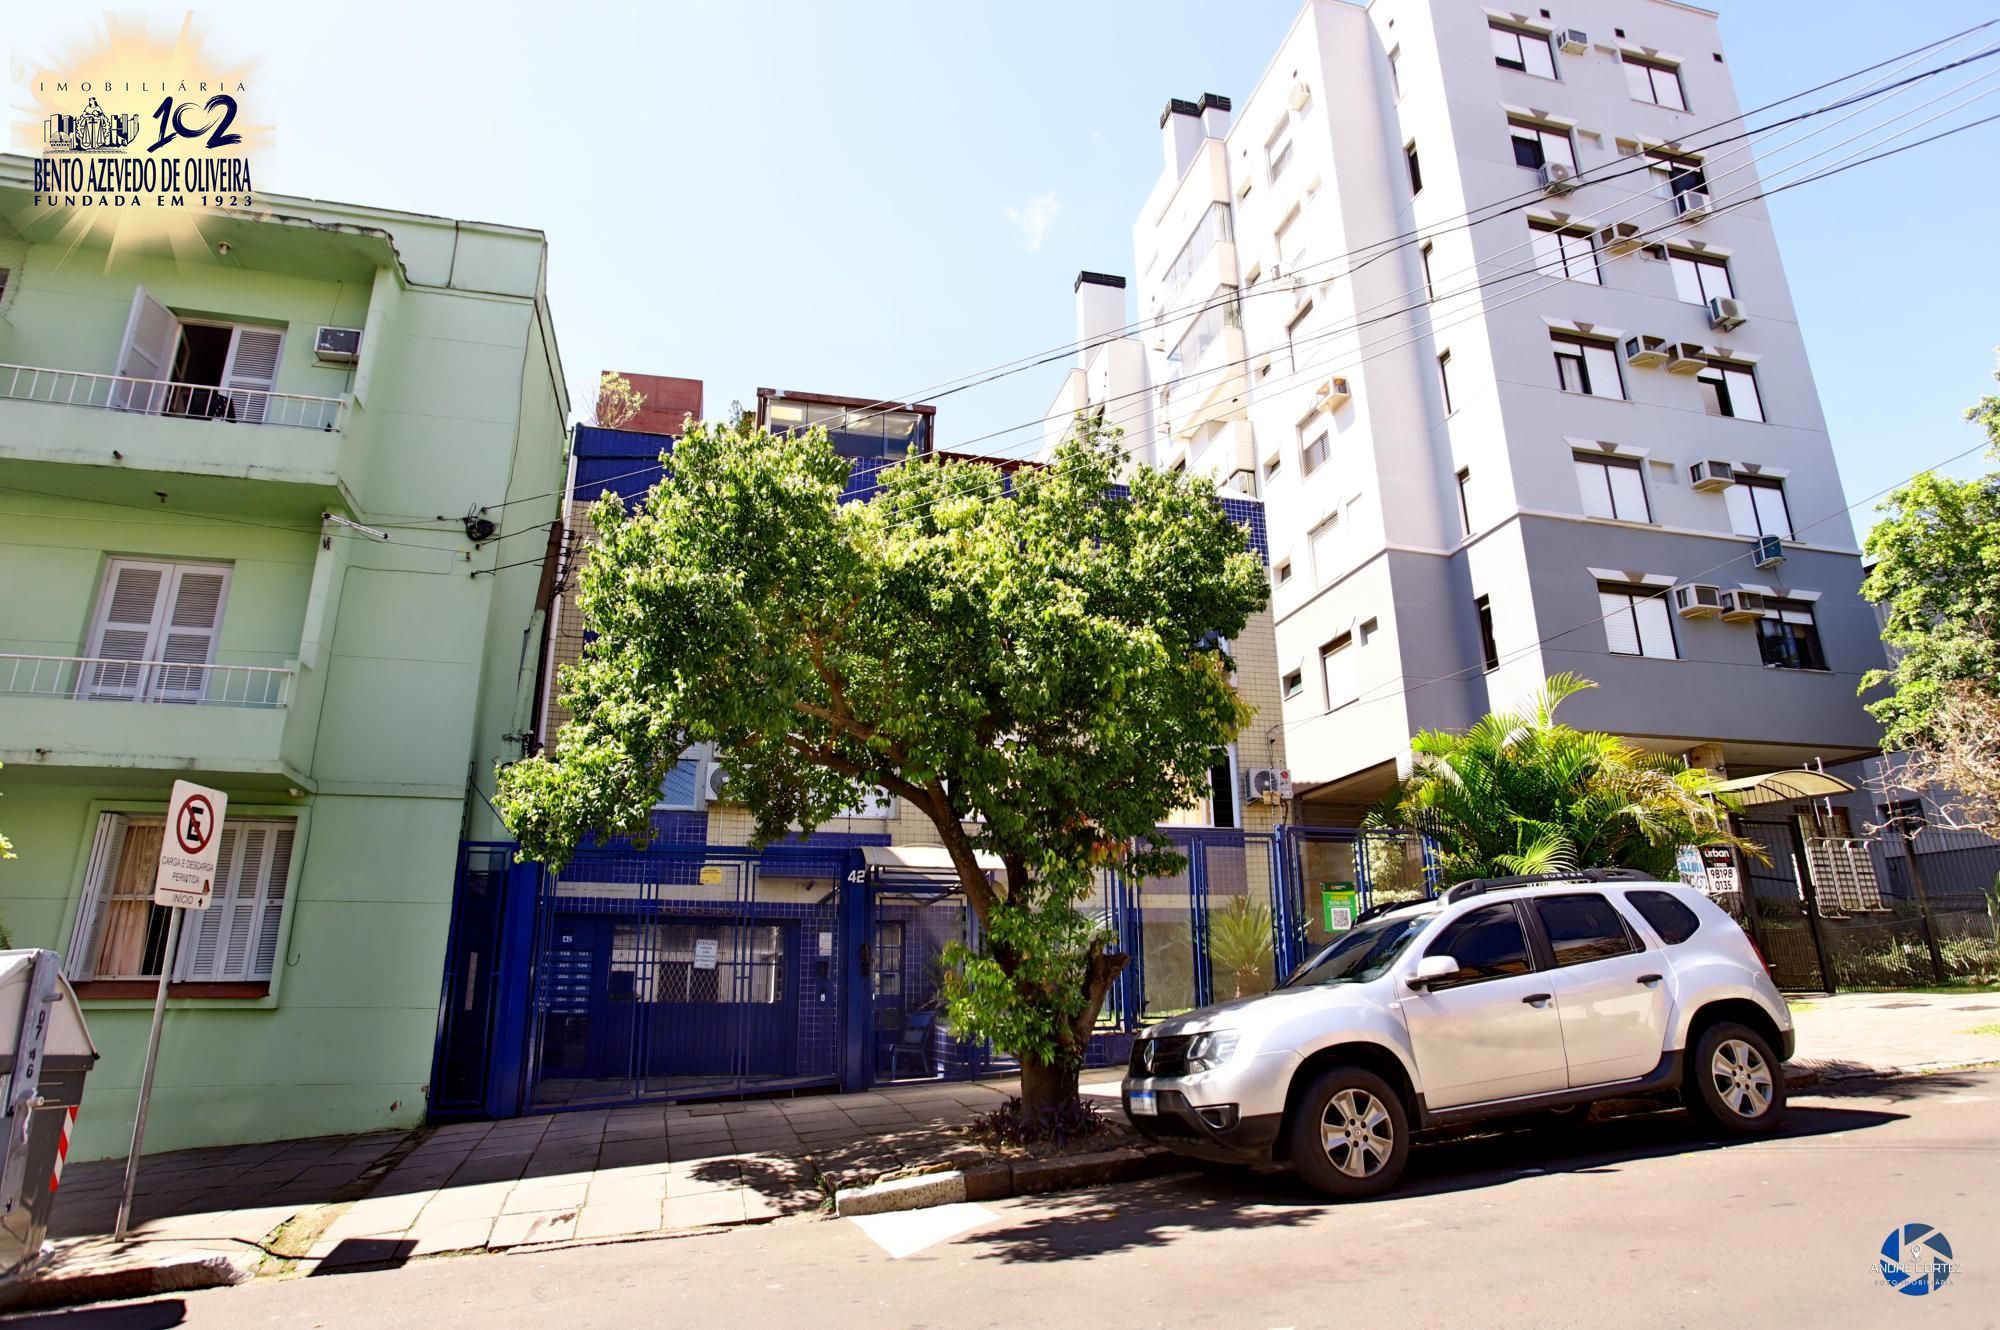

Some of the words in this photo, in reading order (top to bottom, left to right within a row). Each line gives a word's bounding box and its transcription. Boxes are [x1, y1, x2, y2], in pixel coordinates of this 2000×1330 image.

[161, 855, 181, 867] CARGA
[186, 859, 214, 872] DESCARGA
[172, 872, 200, 884] PERMITIDA
[848, 870, 866, 883] 42
[1543, 872, 1584, 880] DUSTER
[1710, 868, 1733, 879] 98198
[1714, 880, 1732, 890] 0135
[172, 893, 194, 904] INÍCIO
